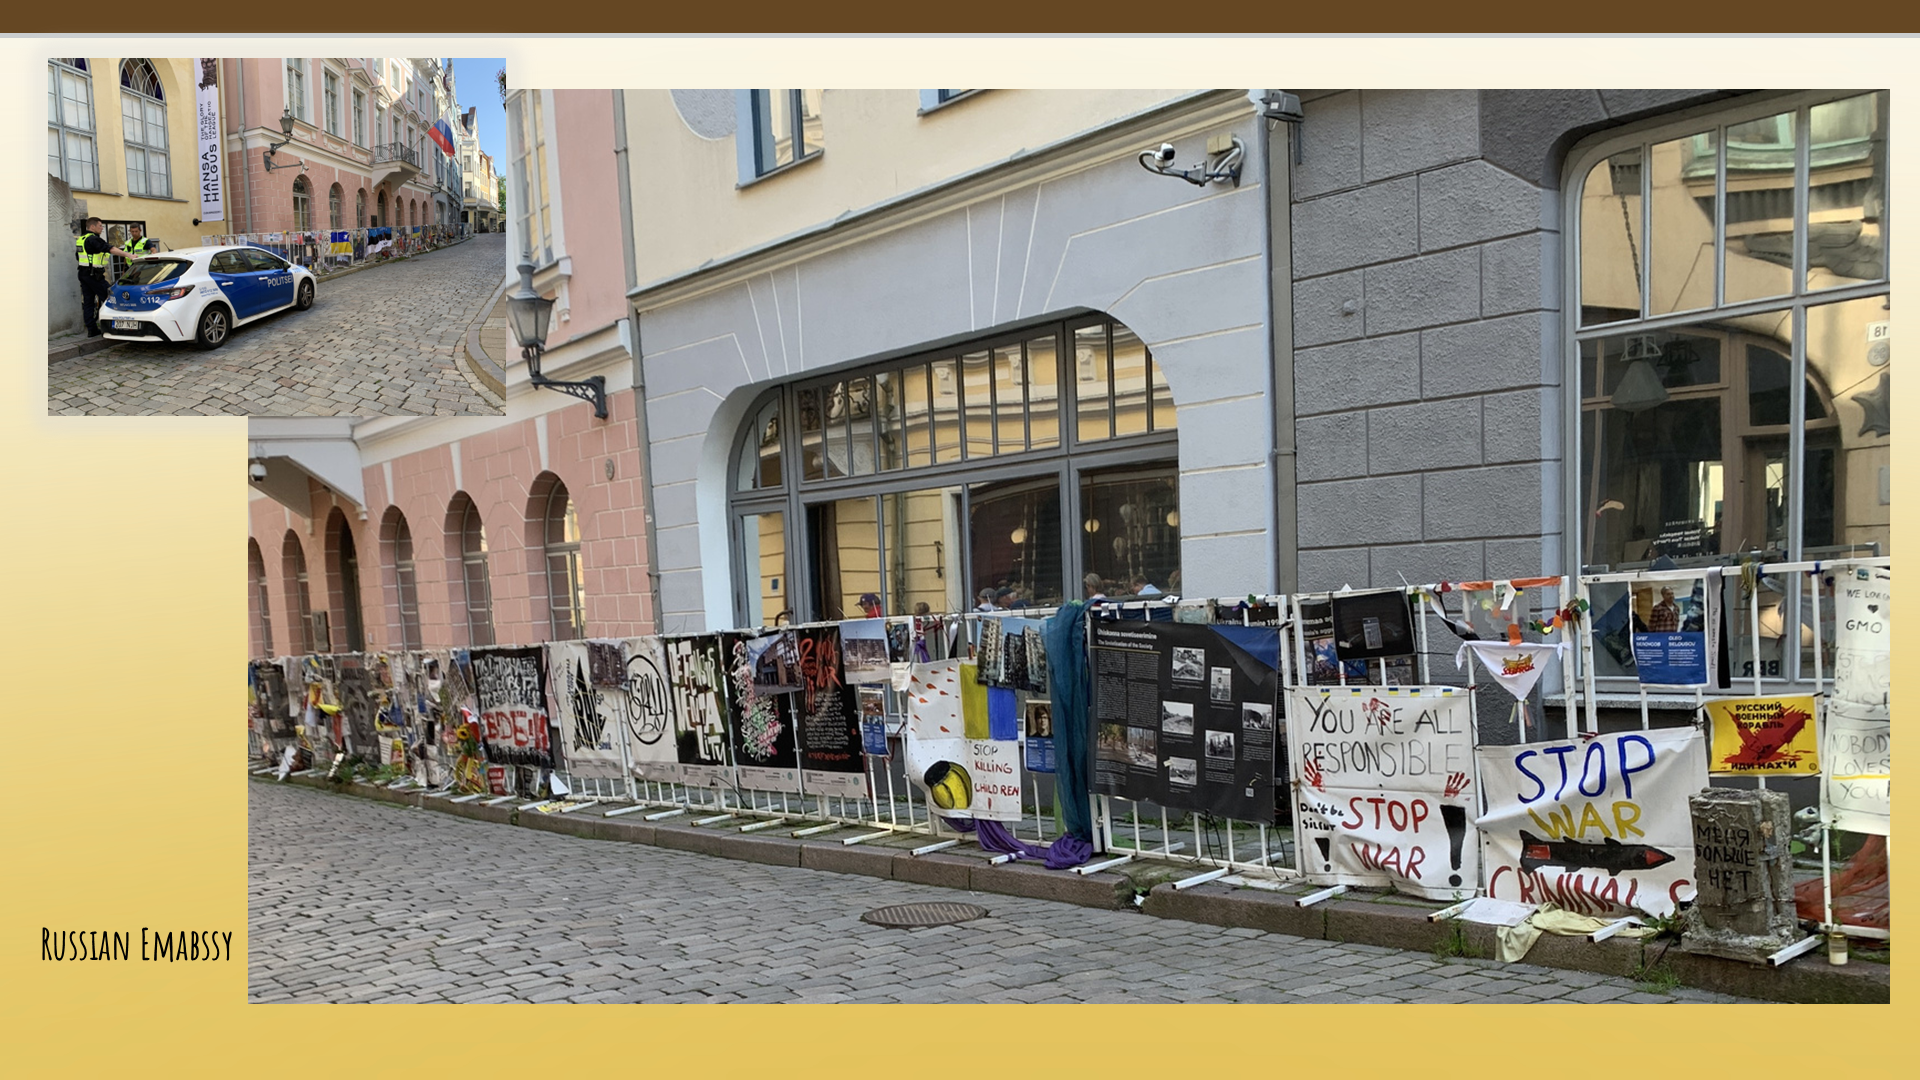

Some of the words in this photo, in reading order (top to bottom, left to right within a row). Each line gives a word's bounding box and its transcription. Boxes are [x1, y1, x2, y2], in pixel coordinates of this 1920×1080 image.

[202, 152, 211, 203] HANSA
[209, 144, 219, 202] HIILGUS
[267, 275, 293, 288] POLITSEI
[147, 296, 160, 304] 112
[1846, 589, 1861, 598] WE
[1845, 619, 1882, 634] GMO
[1304, 695, 1354, 734] YOU
[1365, 706, 1404, 736] ARE
[1414, 708, 1462, 734] ALL
[1735, 701, 1782, 712] РУССКИЙ
[1735, 711, 1785, 721] ВОЕННЫЙ
[973, 743, 998, 756] STOP
[1832, 733, 1890, 755] NOBOD
[1302, 739, 1463, 777] RESPONSIBLE
[1514, 735, 1656, 803] STOP
[1731, 762, 1754, 771] ИДИ
[1341, 796, 1429, 833] STOP
[1527, 801, 1645, 840] WAR
[1696, 824, 1750, 848] МЕНЯ
[1351, 842, 1426, 880] WAR
[1695, 843, 1755, 867] БОЛЬШЕ
[1708, 867, 1752, 893] НЕТ
